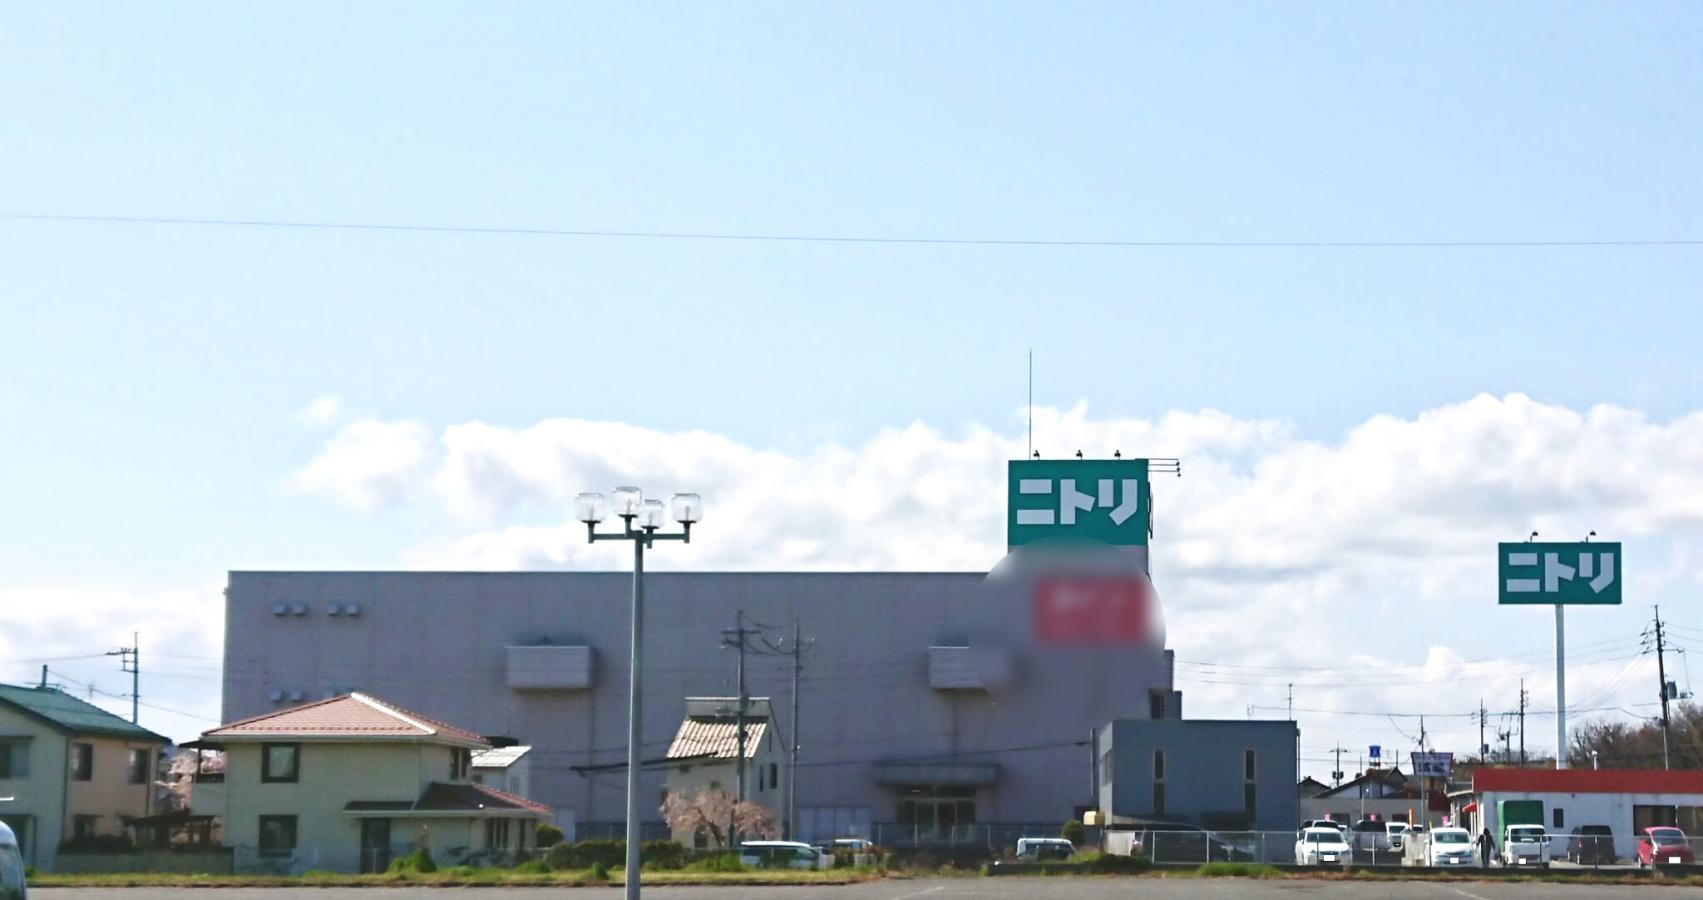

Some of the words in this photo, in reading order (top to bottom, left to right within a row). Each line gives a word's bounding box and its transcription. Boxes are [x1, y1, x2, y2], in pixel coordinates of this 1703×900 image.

[1016, 479, 1138, 526] ニトリ
[1506, 552, 1614, 593] ニトリ
